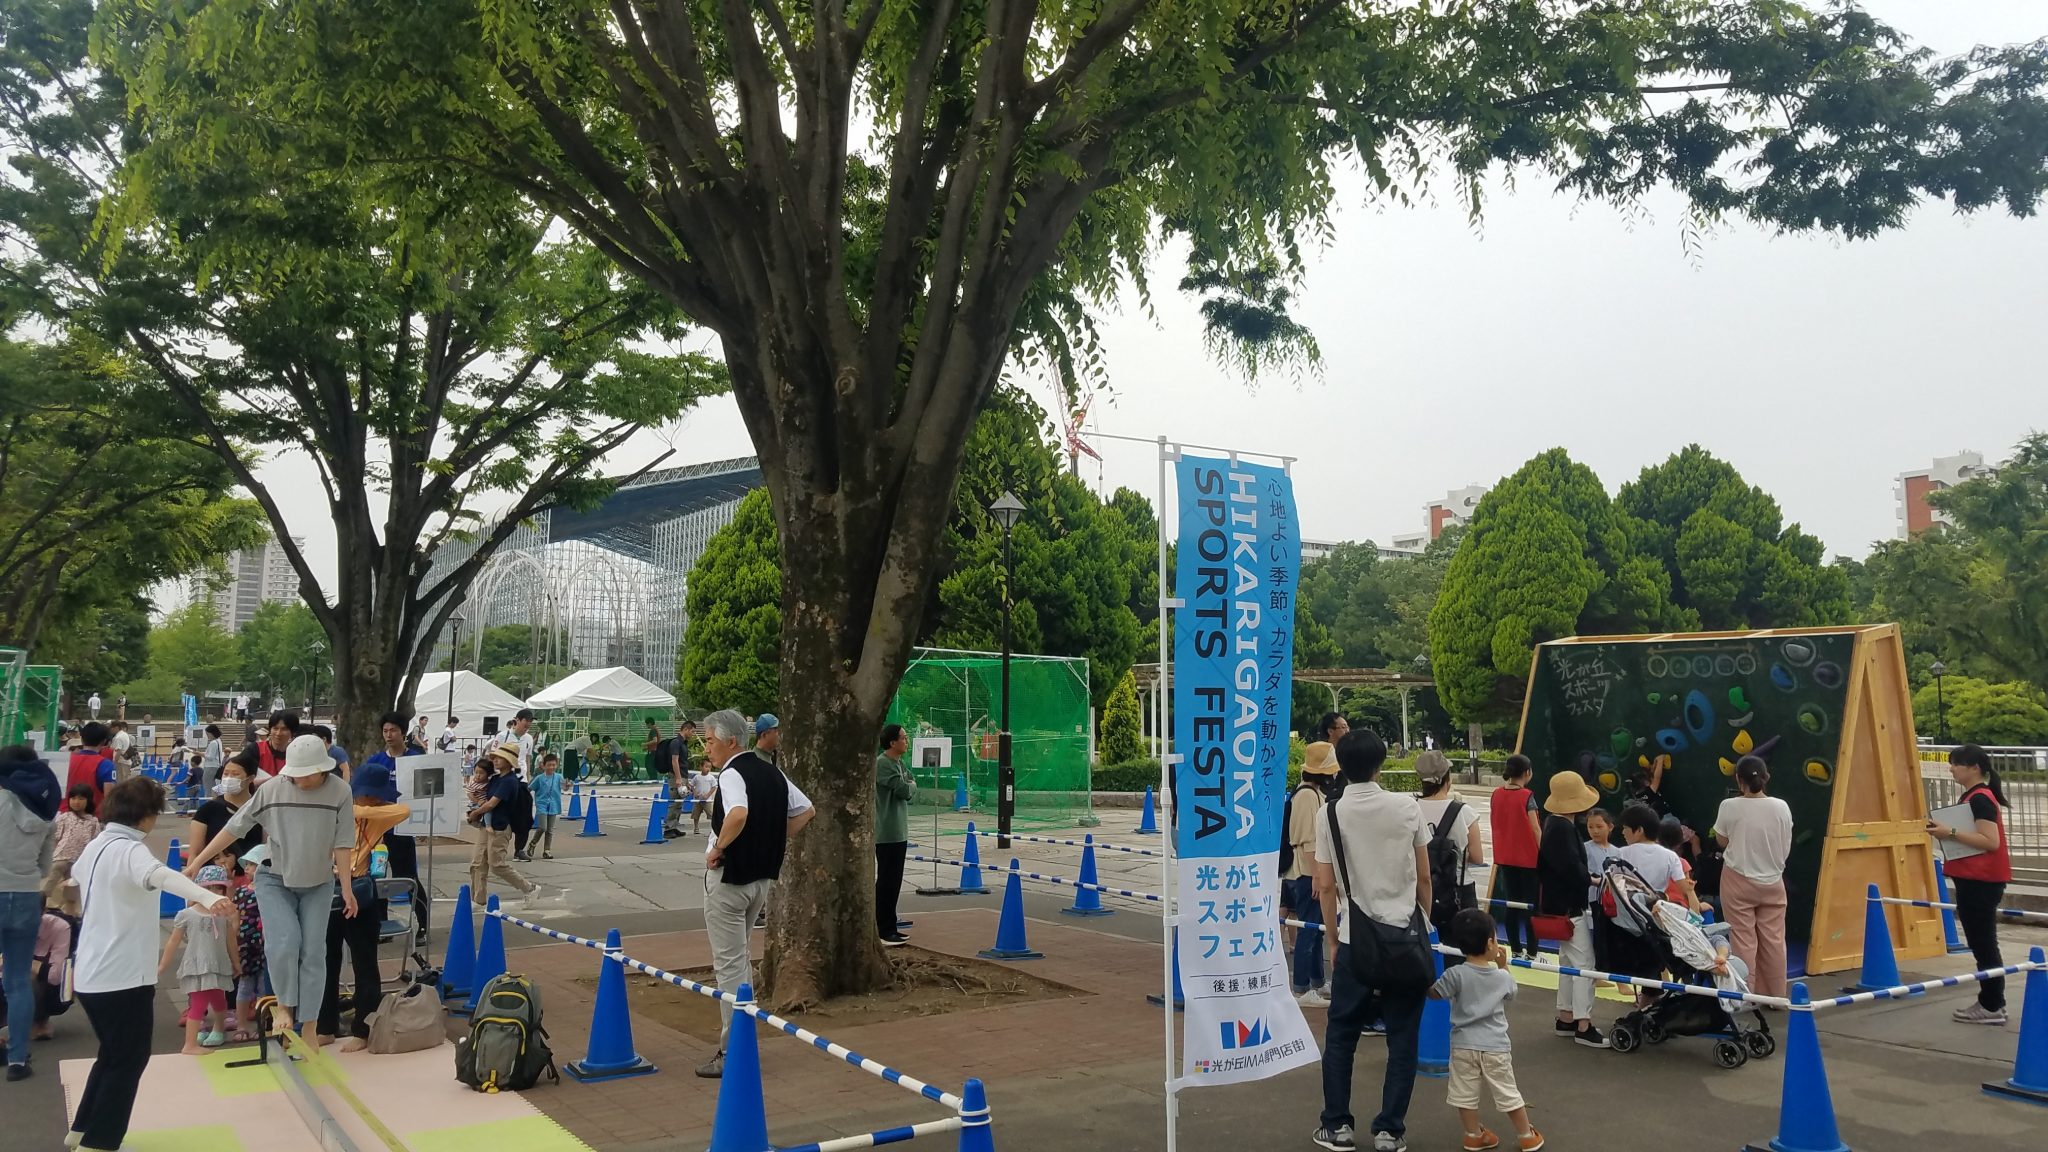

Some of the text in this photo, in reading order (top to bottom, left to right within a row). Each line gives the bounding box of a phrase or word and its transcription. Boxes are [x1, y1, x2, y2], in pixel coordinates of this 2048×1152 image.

[1192, 467, 1230, 842] SPORTS FESTA
[1228, 471, 1261, 841] HIKARIGAOKA
[1556, 658, 1612, 681] 光が丘
[1561, 678, 1611, 699] スポーツ
[1196, 862, 1261, 891] 光が丘
[1198, 894, 1272, 925] スポーツ
[1198, 927, 1275, 959] フェスタ
